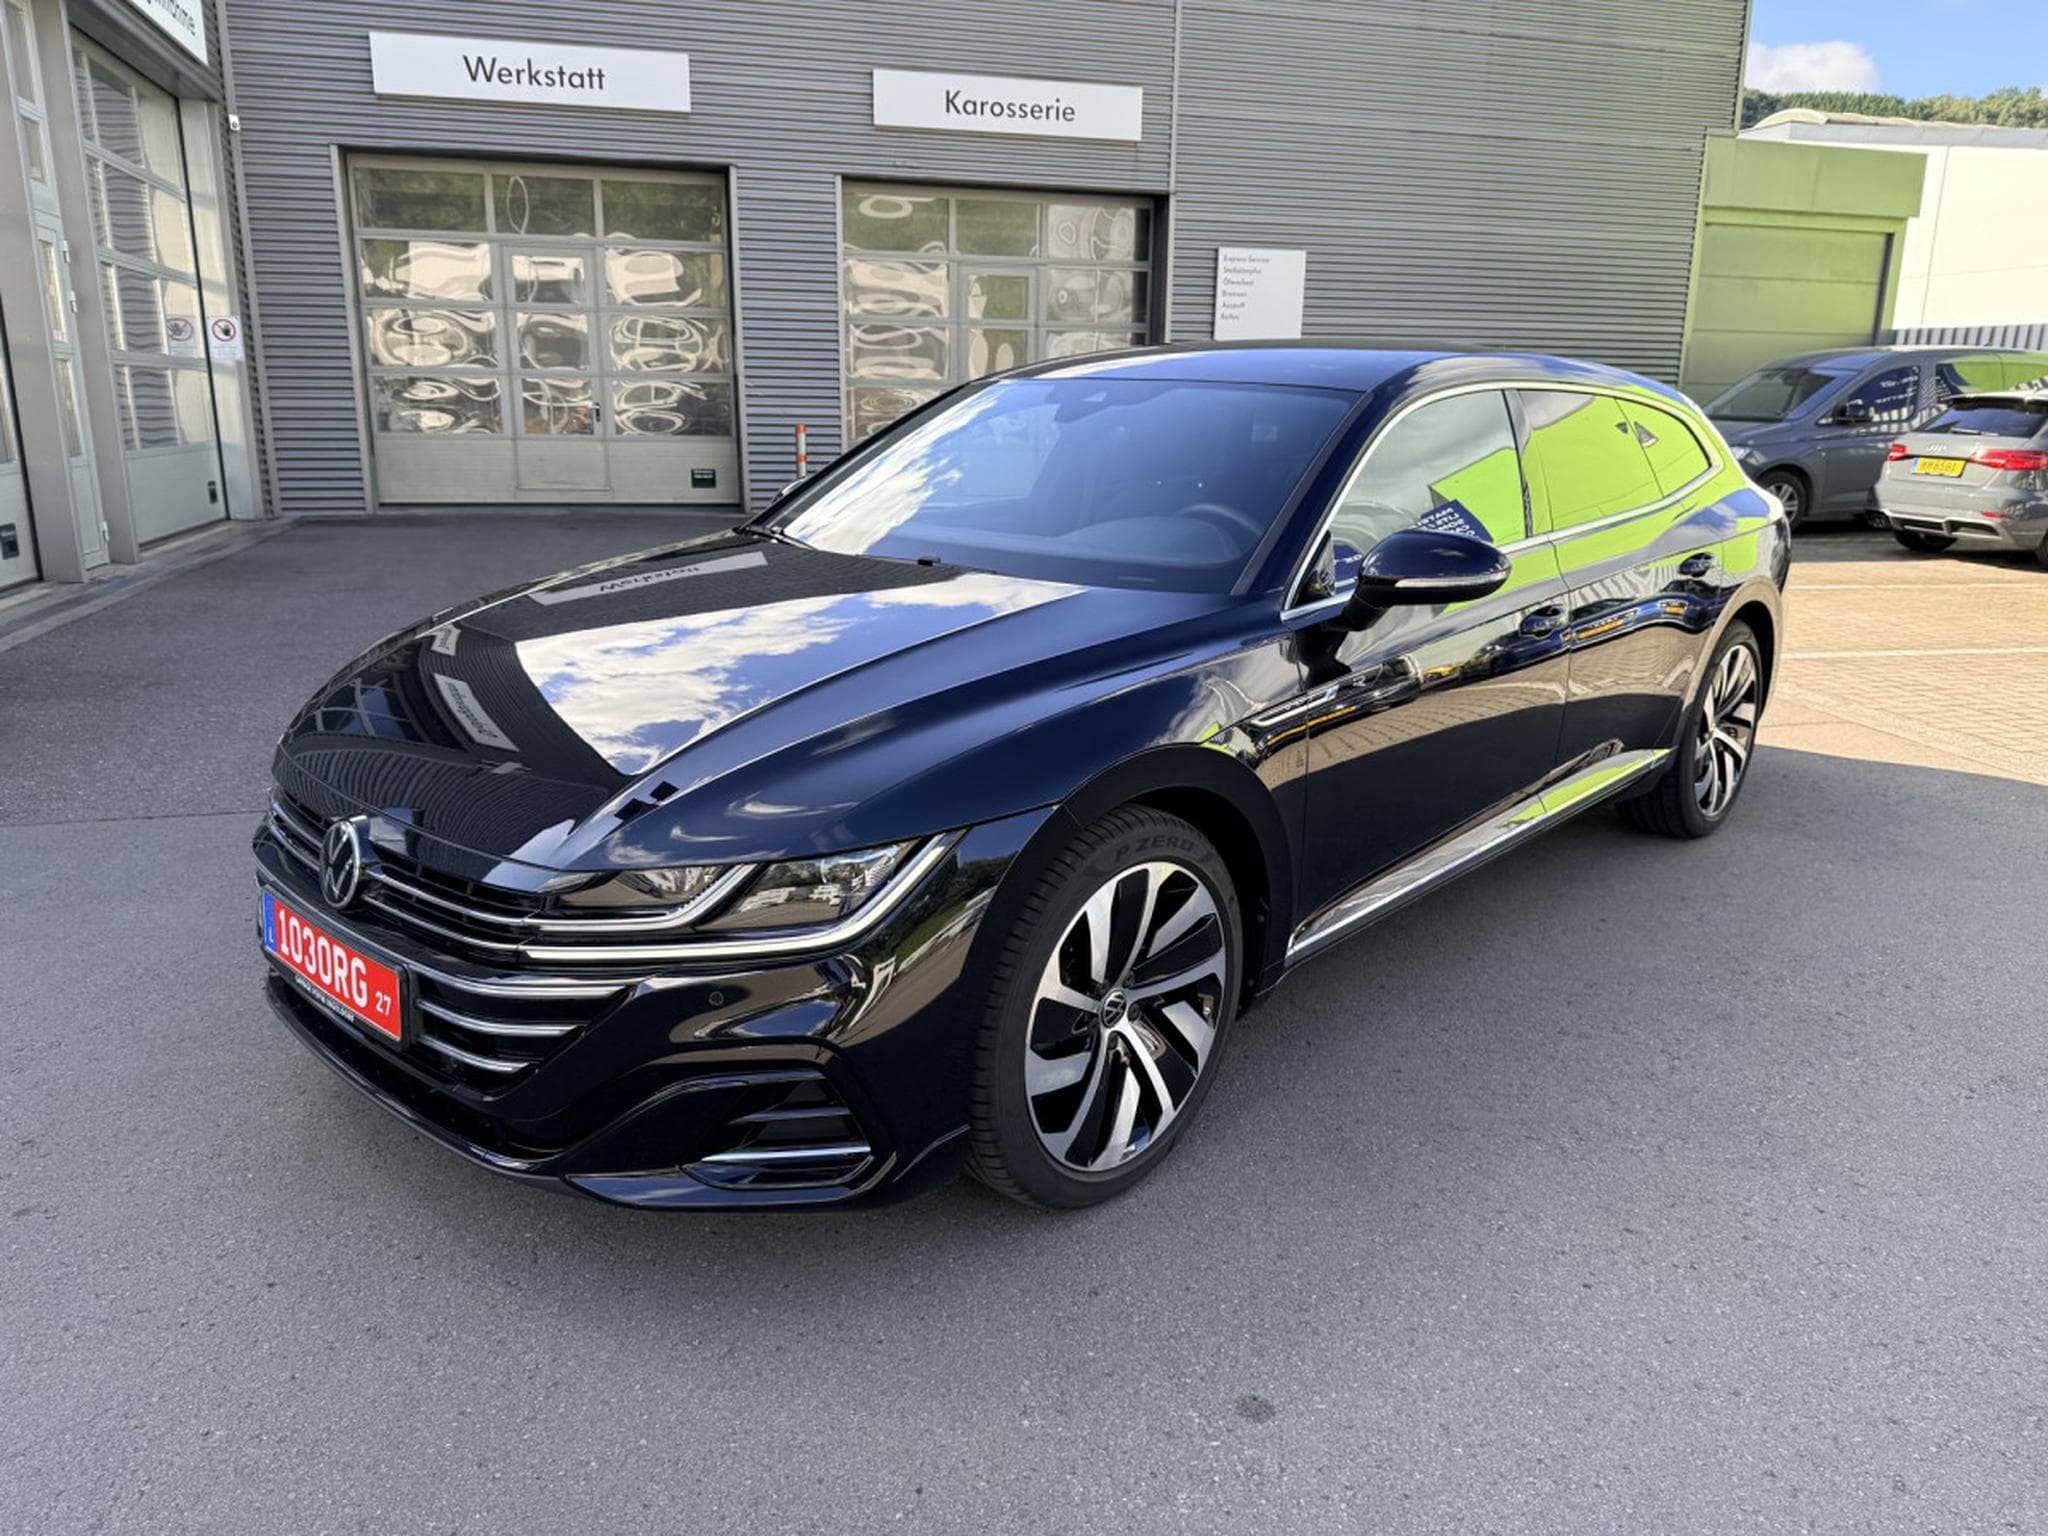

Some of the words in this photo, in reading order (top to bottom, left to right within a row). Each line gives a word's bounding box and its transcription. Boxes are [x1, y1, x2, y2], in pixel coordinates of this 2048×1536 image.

[462, 54, 606, 91] Werkstatt
[945, 88, 1076, 122] Karosserie
[375, 991, 392, 1017] 27
